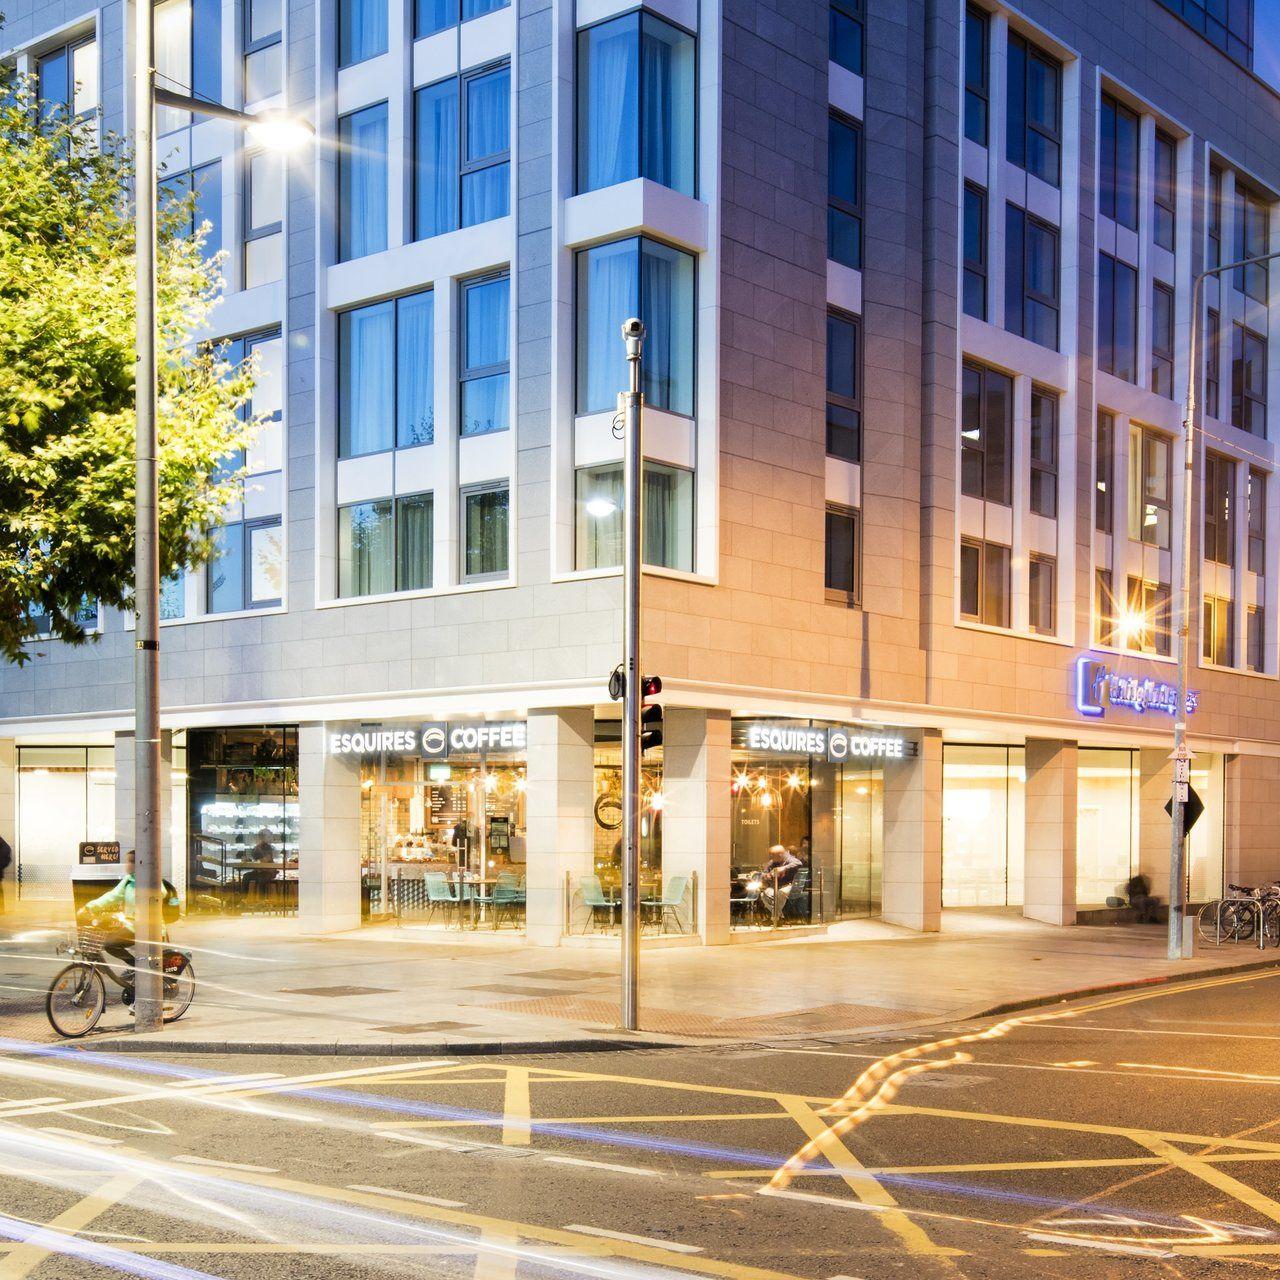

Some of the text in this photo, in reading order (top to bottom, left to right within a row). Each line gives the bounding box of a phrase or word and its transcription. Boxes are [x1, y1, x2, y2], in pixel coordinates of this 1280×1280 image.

[330, 724, 526, 754] ESQUIRES COFFEE
[751, 727, 904, 757] ESQUIRES COFFEE
